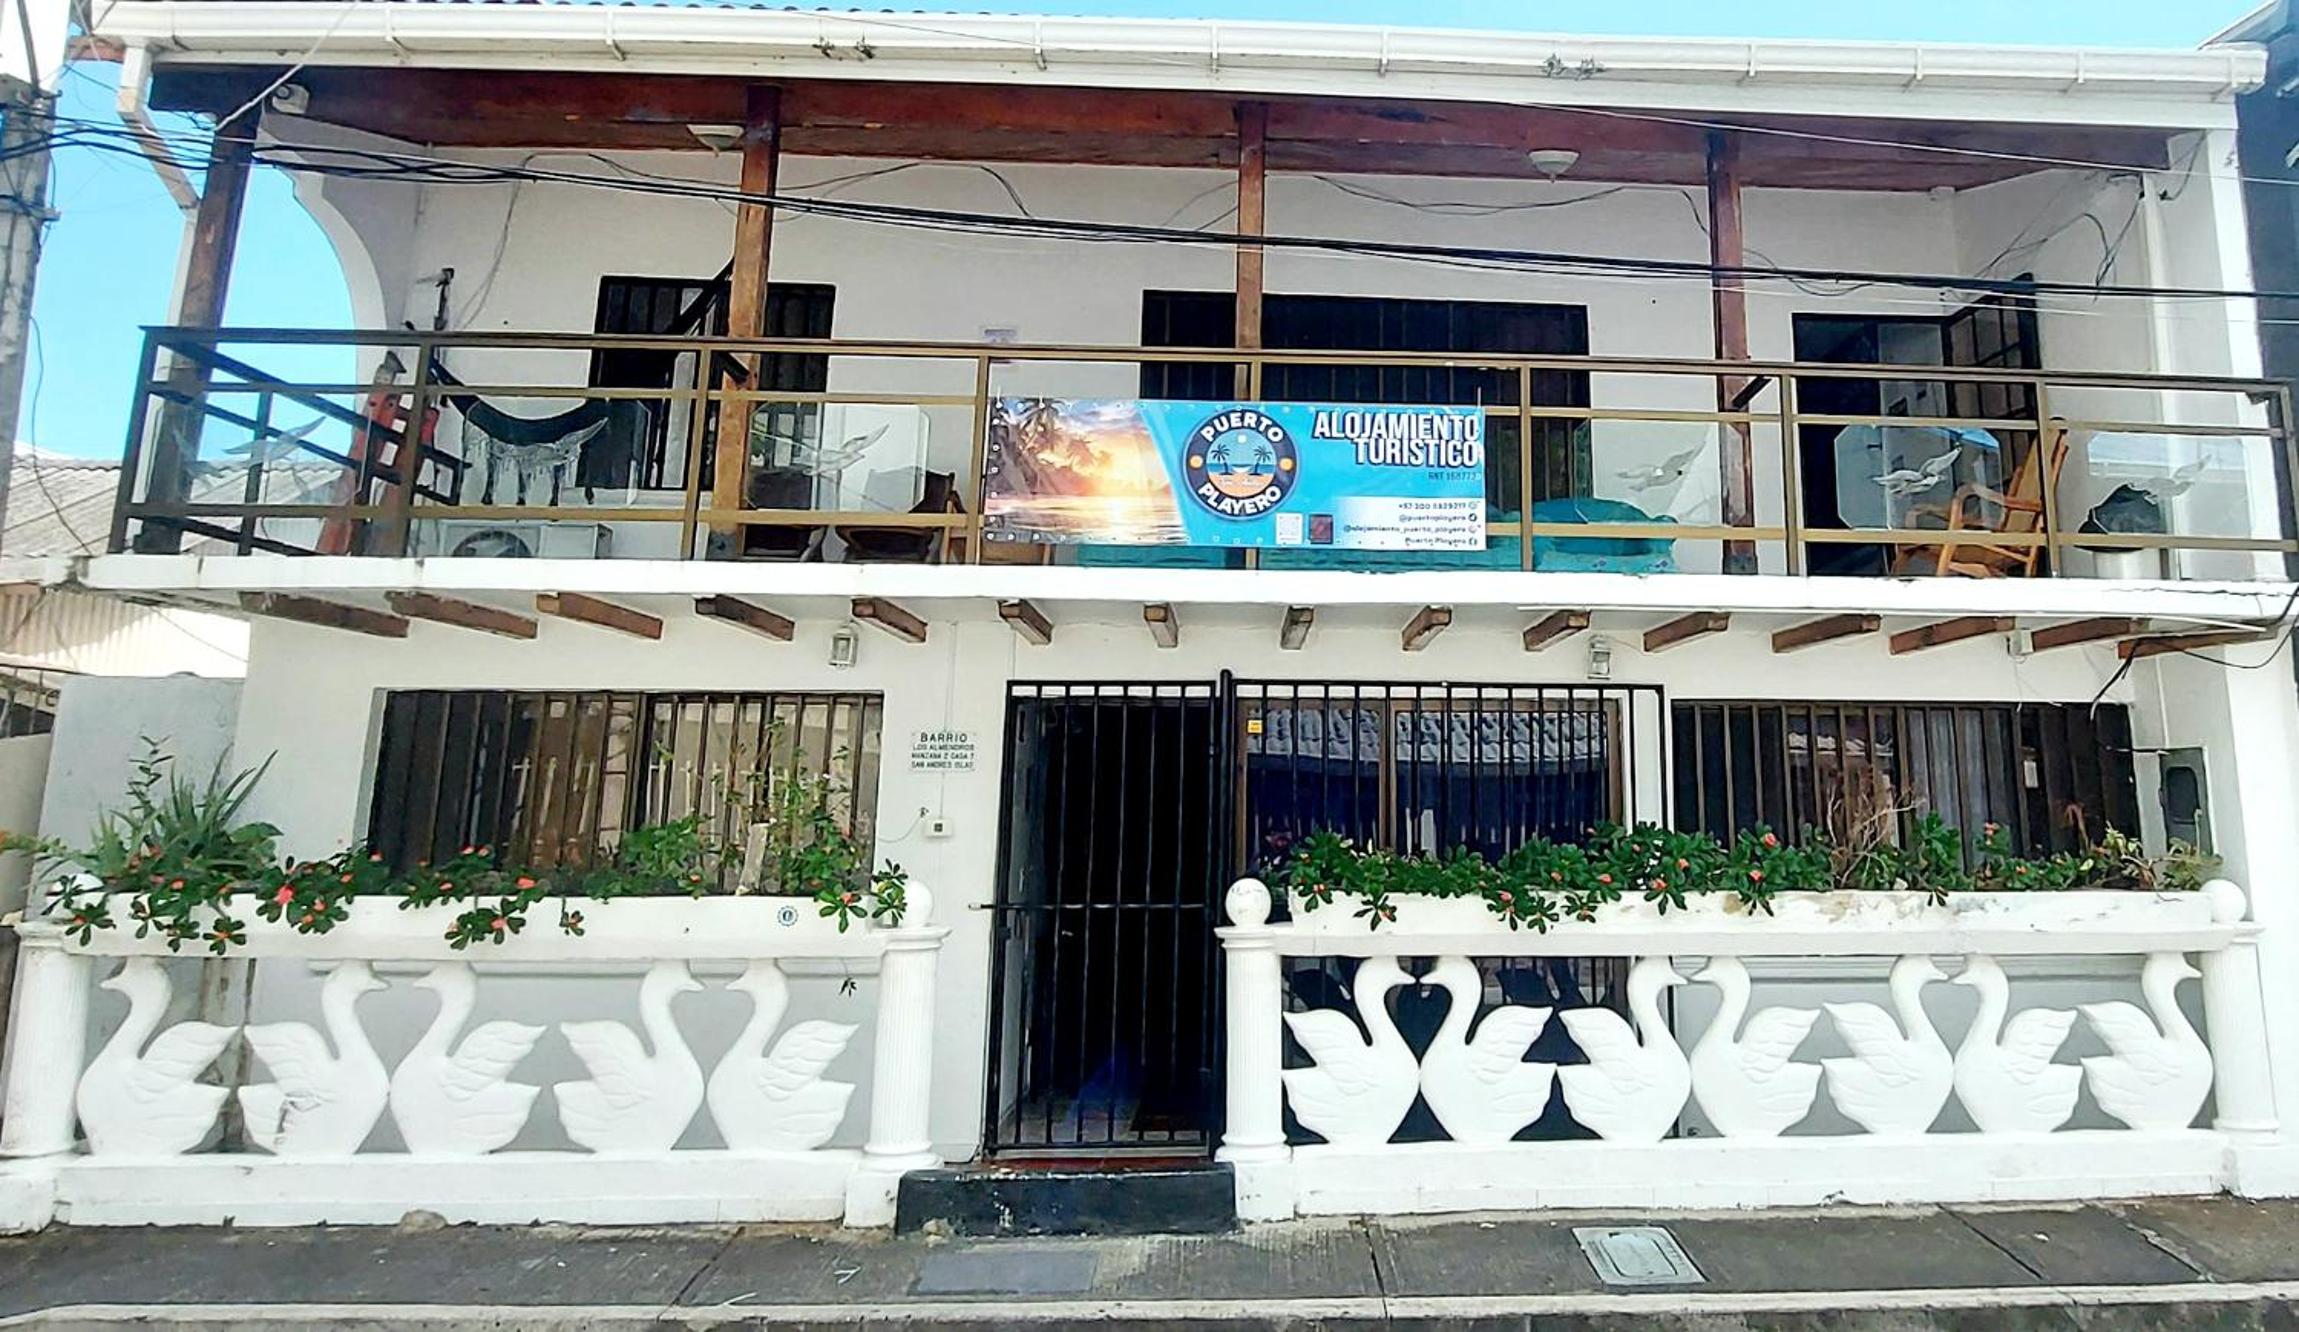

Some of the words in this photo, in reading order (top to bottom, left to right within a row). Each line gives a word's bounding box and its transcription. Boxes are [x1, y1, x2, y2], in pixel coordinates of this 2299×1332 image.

[1200, 412, 1284, 442] PUERTO
[1313, 411, 1479, 441] ALOJAMIENTO
[1198, 483, 1282, 515] PLAYERO
[920, 732, 968, 743] BARRIO
